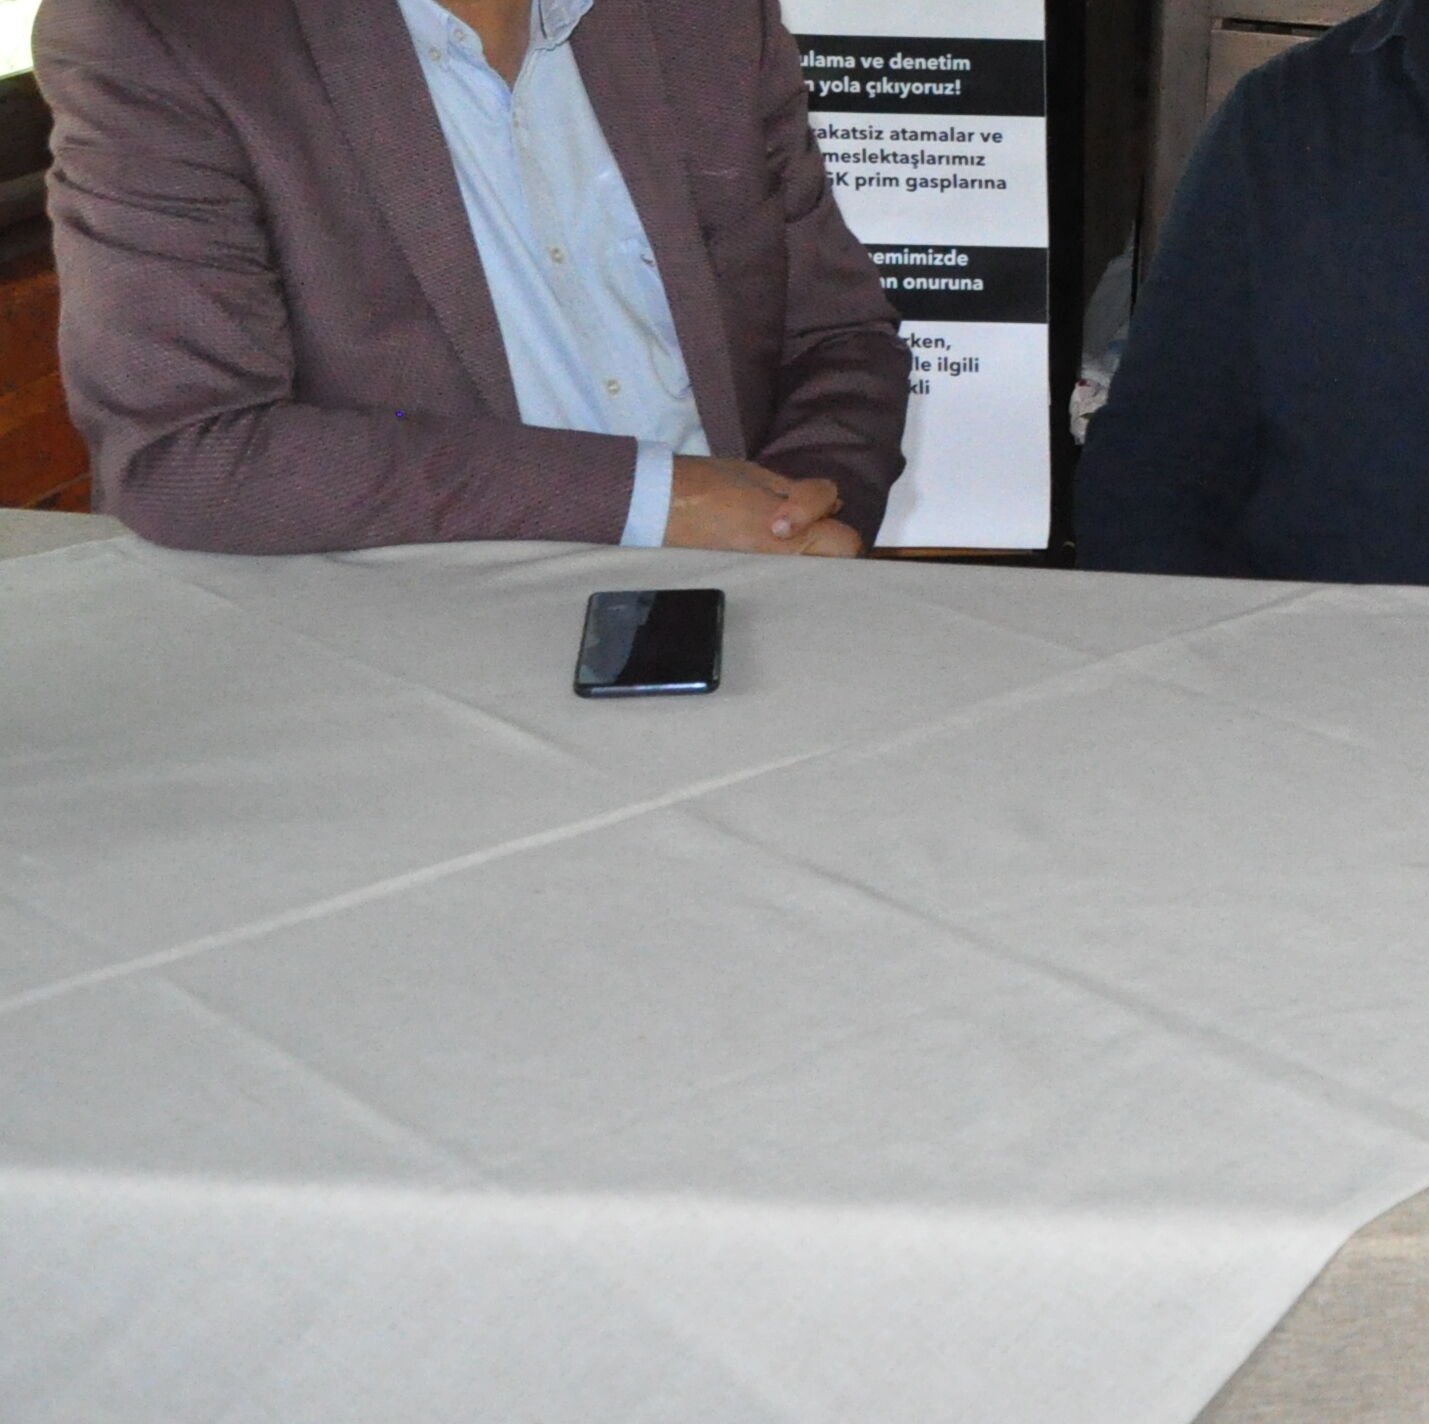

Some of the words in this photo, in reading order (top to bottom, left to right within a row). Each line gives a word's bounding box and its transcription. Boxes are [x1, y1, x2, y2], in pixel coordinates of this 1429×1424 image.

[860, 57, 884, 69] ve
[889, 52, 971, 71] denetim
[819, 76, 861, 97] yola
[865, 76, 961, 99] çıkıyoruz!
[889, 126, 975, 142] atamalar
[980, 132, 1003, 143] ve
[822, 146, 986, 171] meslektaşlarımız
[855, 172, 900, 191] prim
[905, 173, 1007, 193] gasplarına
[903, 277, 983, 291] onuruna
[938, 356, 979, 377] ilgili
